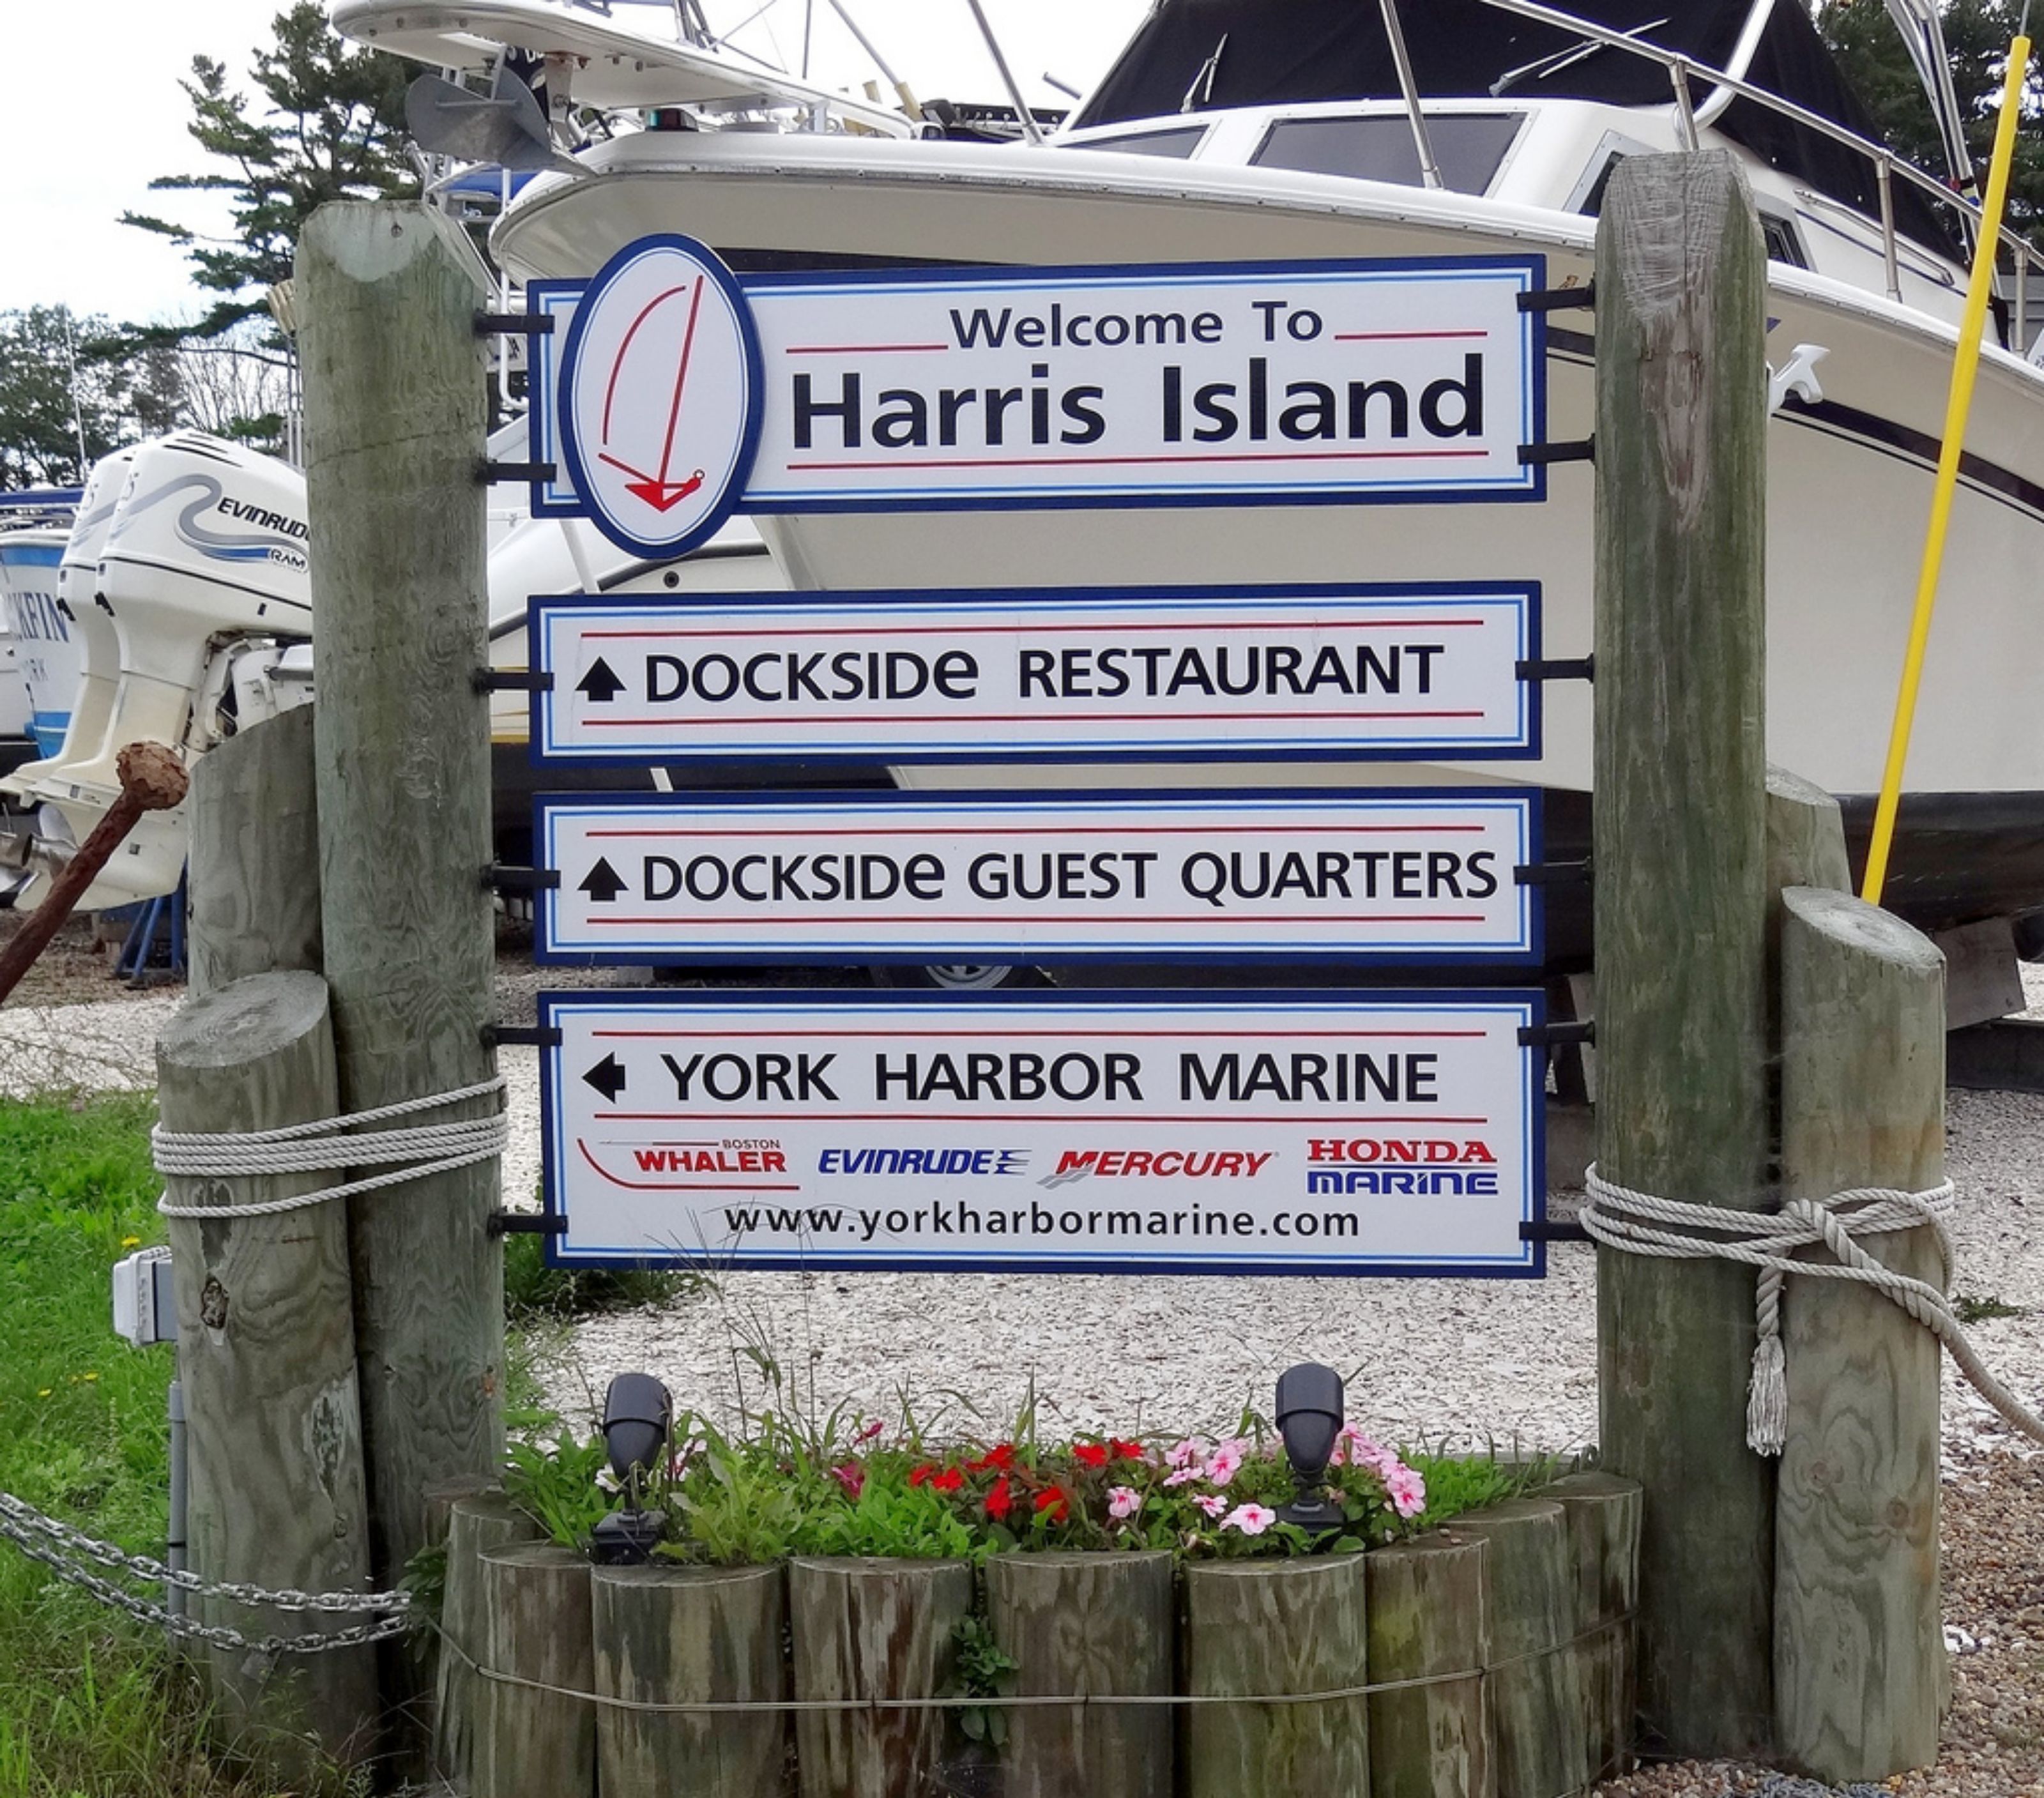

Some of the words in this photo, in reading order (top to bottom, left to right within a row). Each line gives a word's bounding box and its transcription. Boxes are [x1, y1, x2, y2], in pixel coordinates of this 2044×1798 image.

[949, 303, 1223, 349] Welcome
[1251, 301, 1323, 342] To
[793, 363, 1106, 449] Harris
[1163, 353, 1483, 443] Island
[271, 549, 305, 568] RAM
[1019, 644, 1445, 698] RESTAURANT
[968, 852, 1158, 901] GUEST
[1181, 850, 1498, 907] QUARTERS
[660, 1053, 840, 1102] YORK
[875, 1052, 1144, 1101] HARBOR
[1180, 1053, 1438, 1102] MARINE
[722, 1139, 781, 1149] BOSTON
[1307, 1139, 1498, 1162] HONDA
[634, 1150, 787, 1172] WHALER
[818, 1149, 995, 1175] EVINRUDE
[1055, 1151, 1272, 1177] MERCURY
[1308, 1171, 1499, 1195] MARINE
[724, 1201, 1359, 1240] www.yorkharbormarine.com
